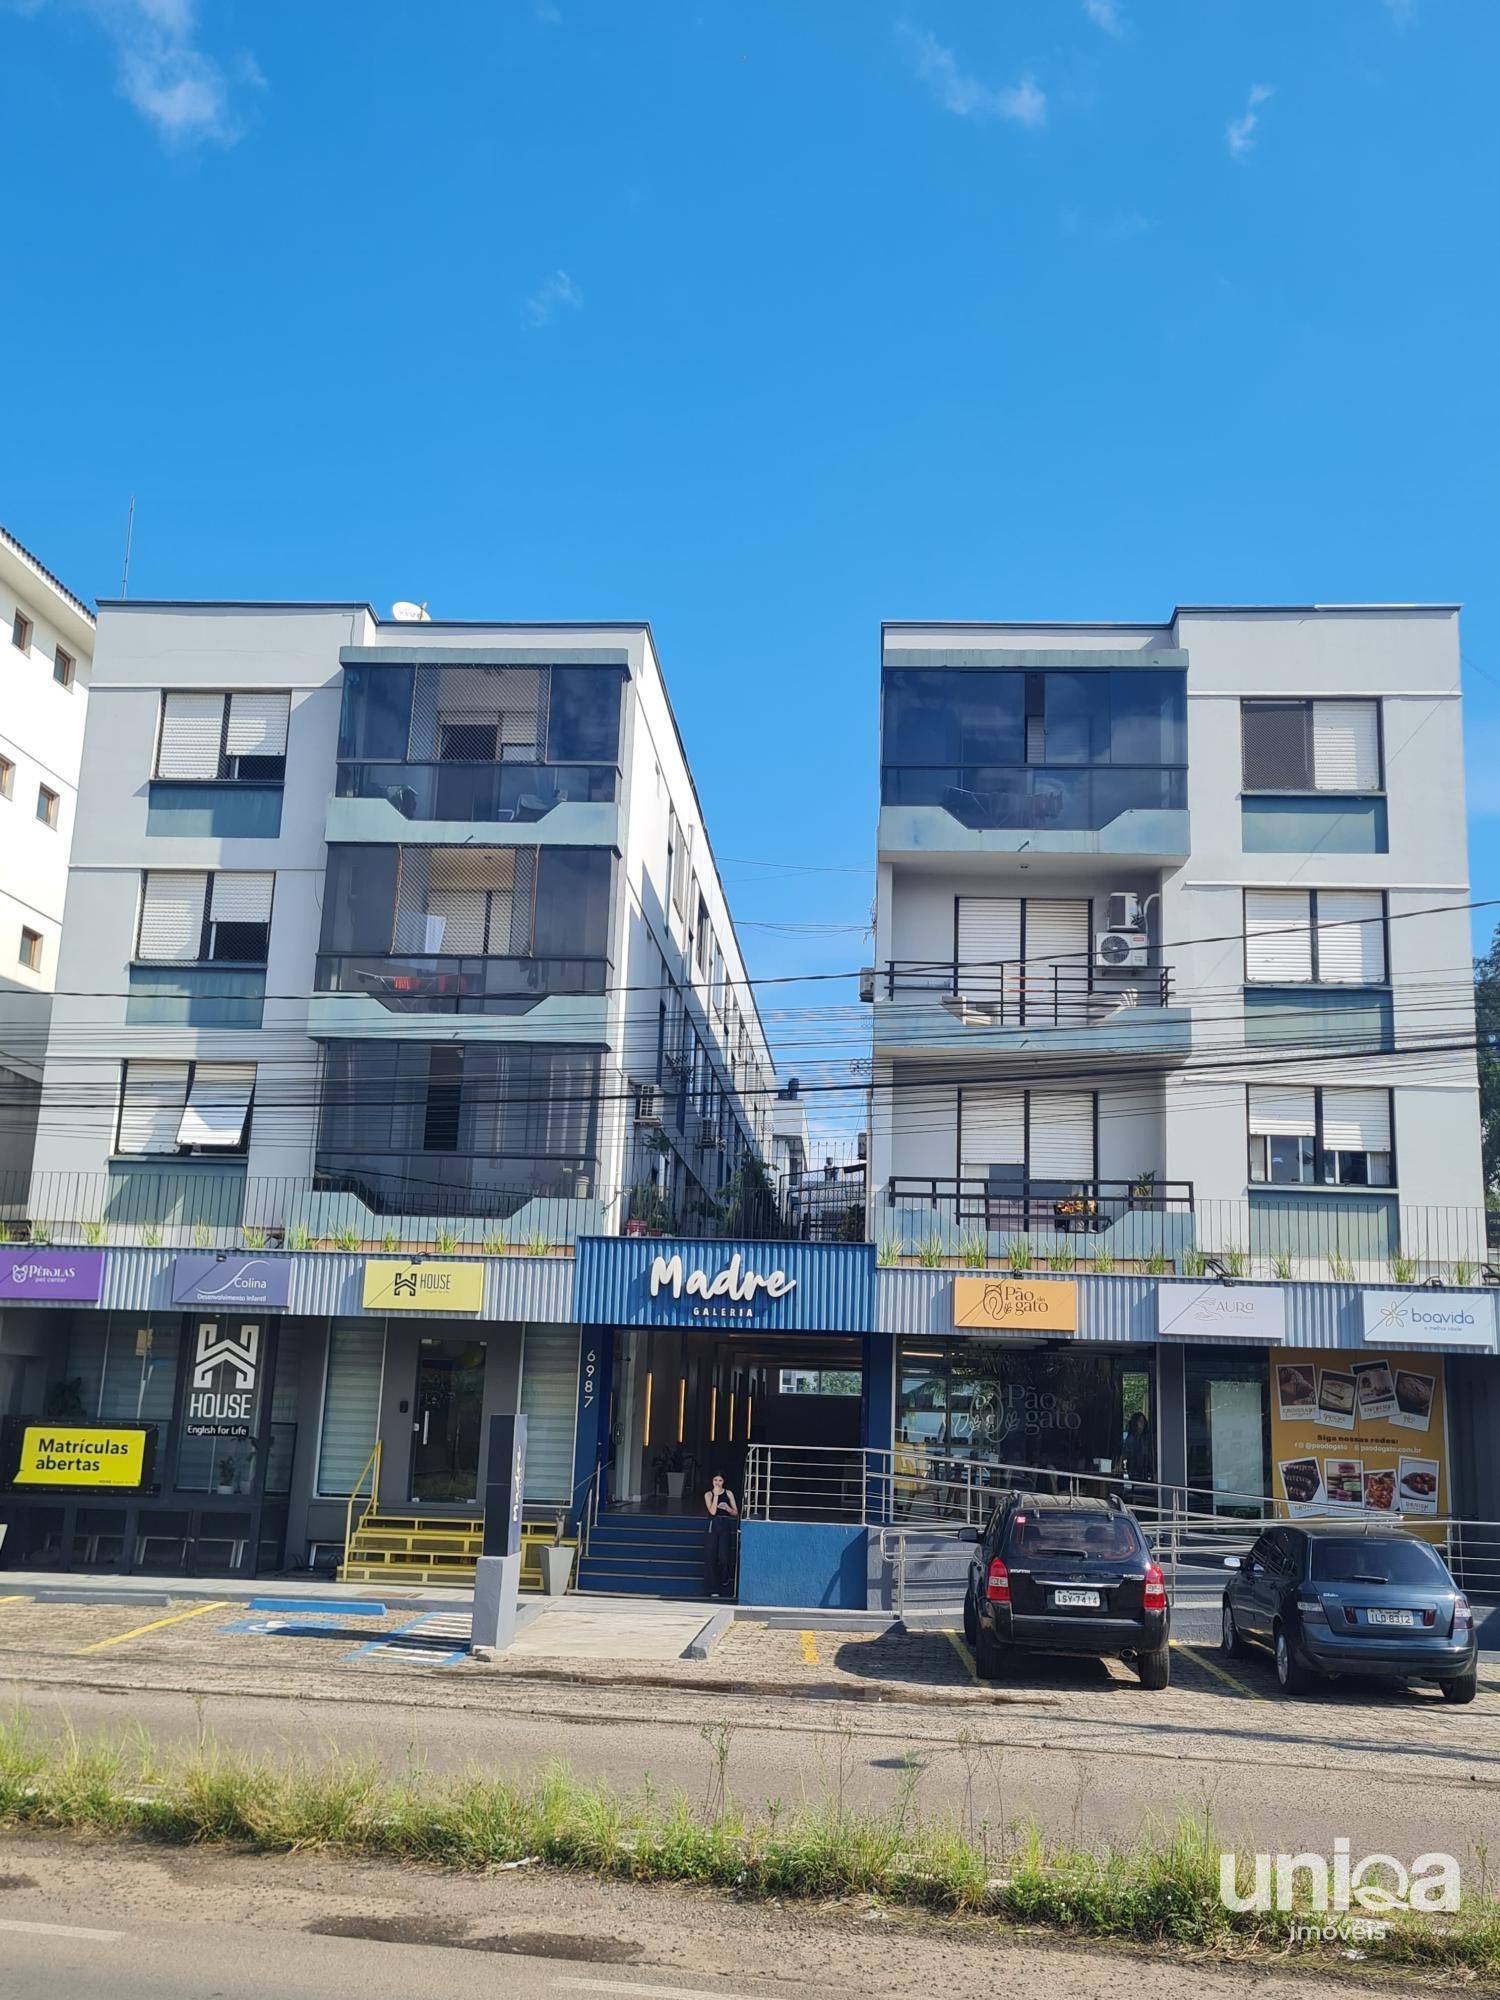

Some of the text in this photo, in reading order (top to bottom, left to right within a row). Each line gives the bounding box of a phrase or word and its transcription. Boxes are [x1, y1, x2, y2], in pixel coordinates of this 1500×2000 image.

[29, 1265, 76, 1278] PÉROLAS
[650, 1253, 797, 1301] Madre
[234, 1278, 267, 1289] Colina
[420, 1273, 452, 1290] HOUSE
[197, 1293, 246, 1302] Desenvolvimento
[1005, 1286, 1034, 1301] Pão
[693, 1307, 753, 1317] GALERIA
[1015, 1300, 1049, 1316] gato
[1411, 1307, 1475, 1325] boavida
[584, 1349, 596, 1408] 6987
[189, 1393, 252, 1419] HOUSE
[1007, 1384, 1057, 1411] Pão
[187, 1425, 247, 1435] English for Life
[1024, 1408, 1082, 1436] gato
[38, 1438, 129, 1455] Matrículas
[1317, 1434, 1337, 1443] Siga
[35, 1455, 100, 1472] abertas
